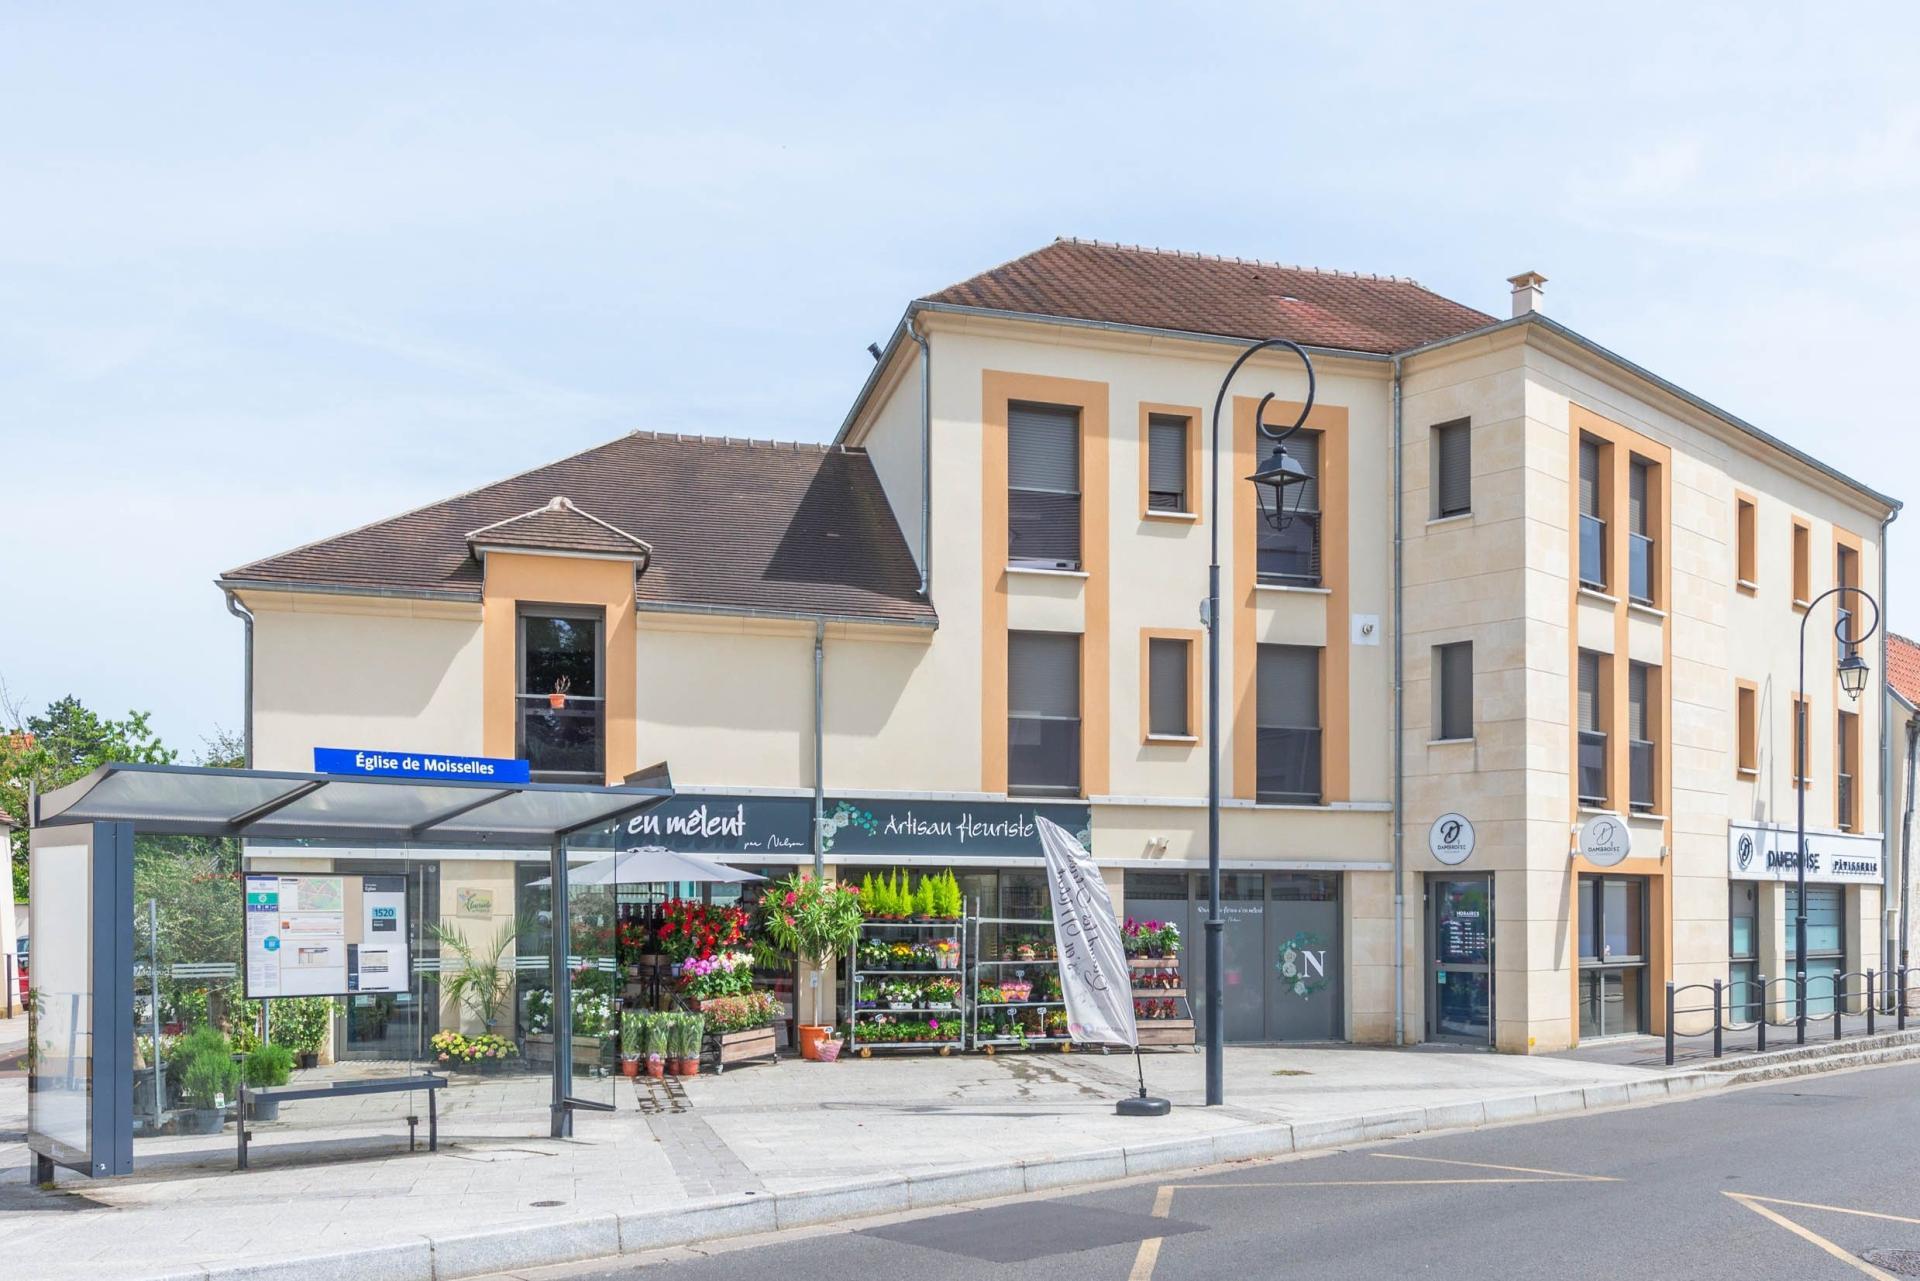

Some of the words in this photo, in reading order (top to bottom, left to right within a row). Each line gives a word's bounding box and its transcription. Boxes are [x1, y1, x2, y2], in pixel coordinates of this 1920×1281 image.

[355, 753, 399, 771] Église
[402, 757, 420, 770] de
[424, 759, 495, 775] Moisselles
[667, 803, 746, 838] mêlent
[884, 811, 952, 836] Artisan
[956, 813, 1034, 844] fleuriste
[374, 908, 394, 917] 1520
[1301, 950, 1327, 978] N
